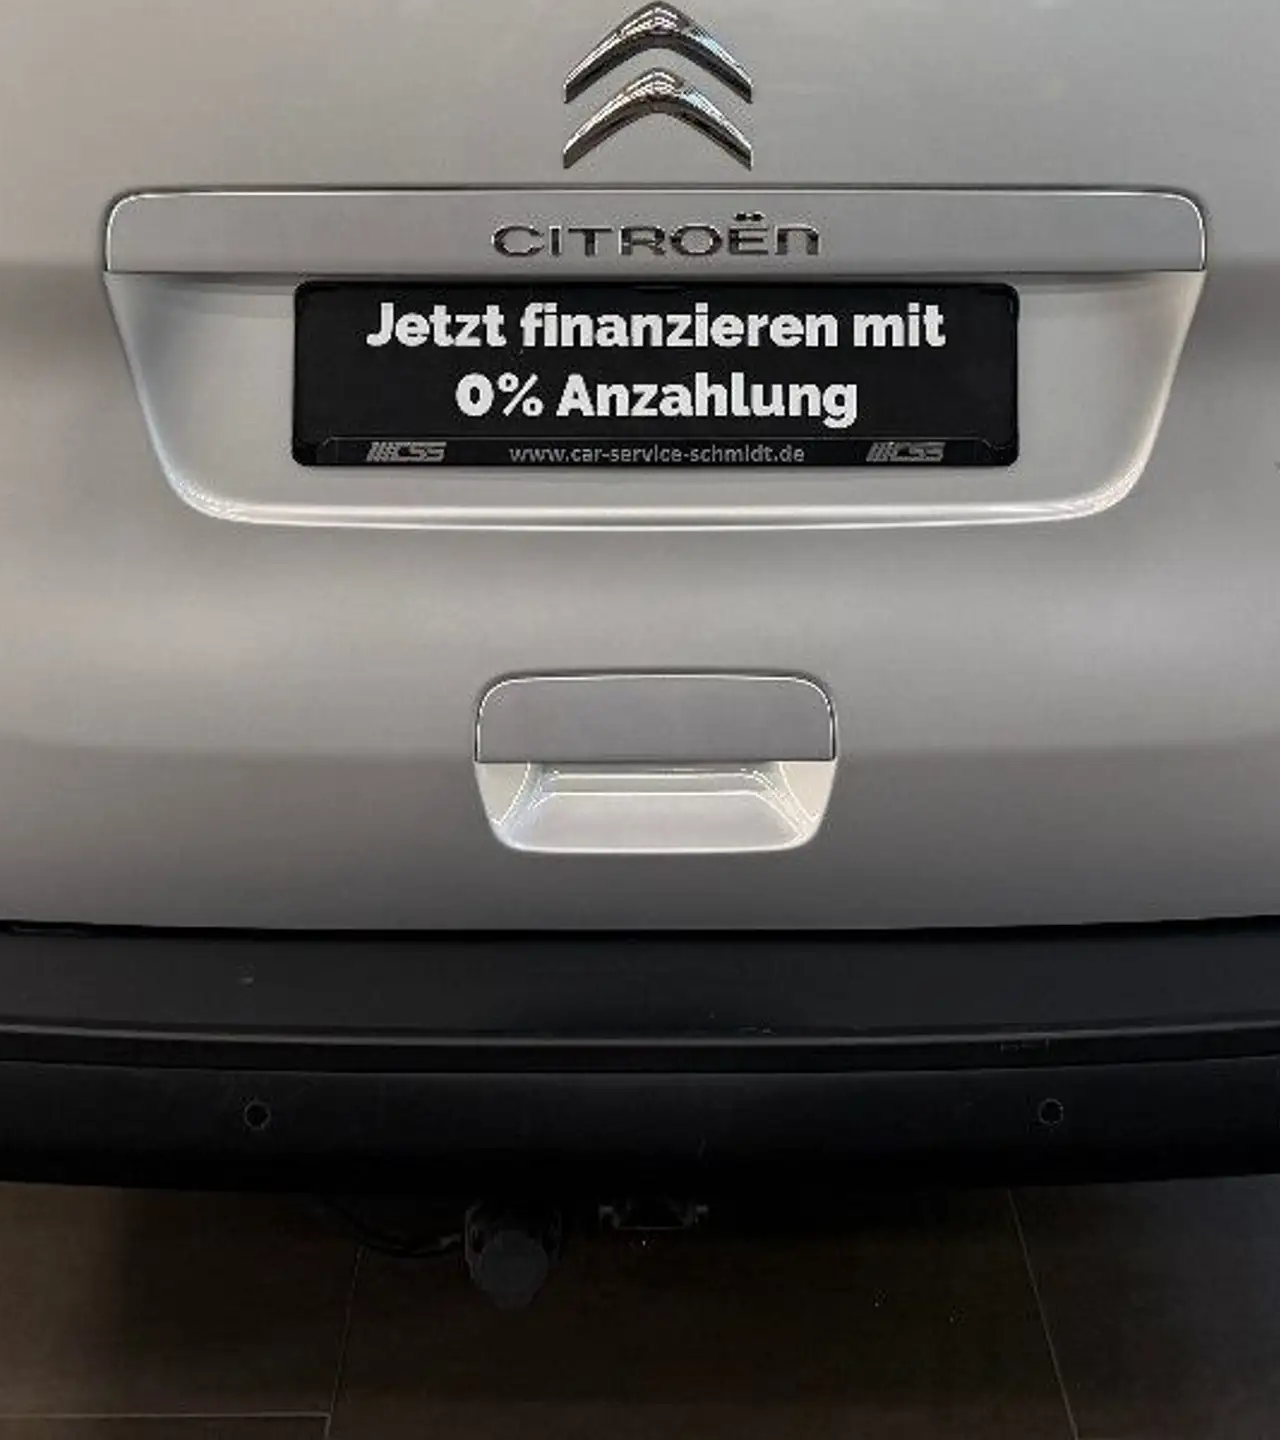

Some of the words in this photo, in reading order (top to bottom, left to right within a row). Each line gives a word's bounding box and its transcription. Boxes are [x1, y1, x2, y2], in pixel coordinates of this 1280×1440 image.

[366, 302, 507, 347] Jetzt
[519, 302, 838, 347] finanzieren
[853, 302, 946, 347] mit
[455, 372, 544, 417] 0%
[555, 371, 859, 429] Anzahlung
[508, 443, 806, 463] www.car-service-schmidt.de
